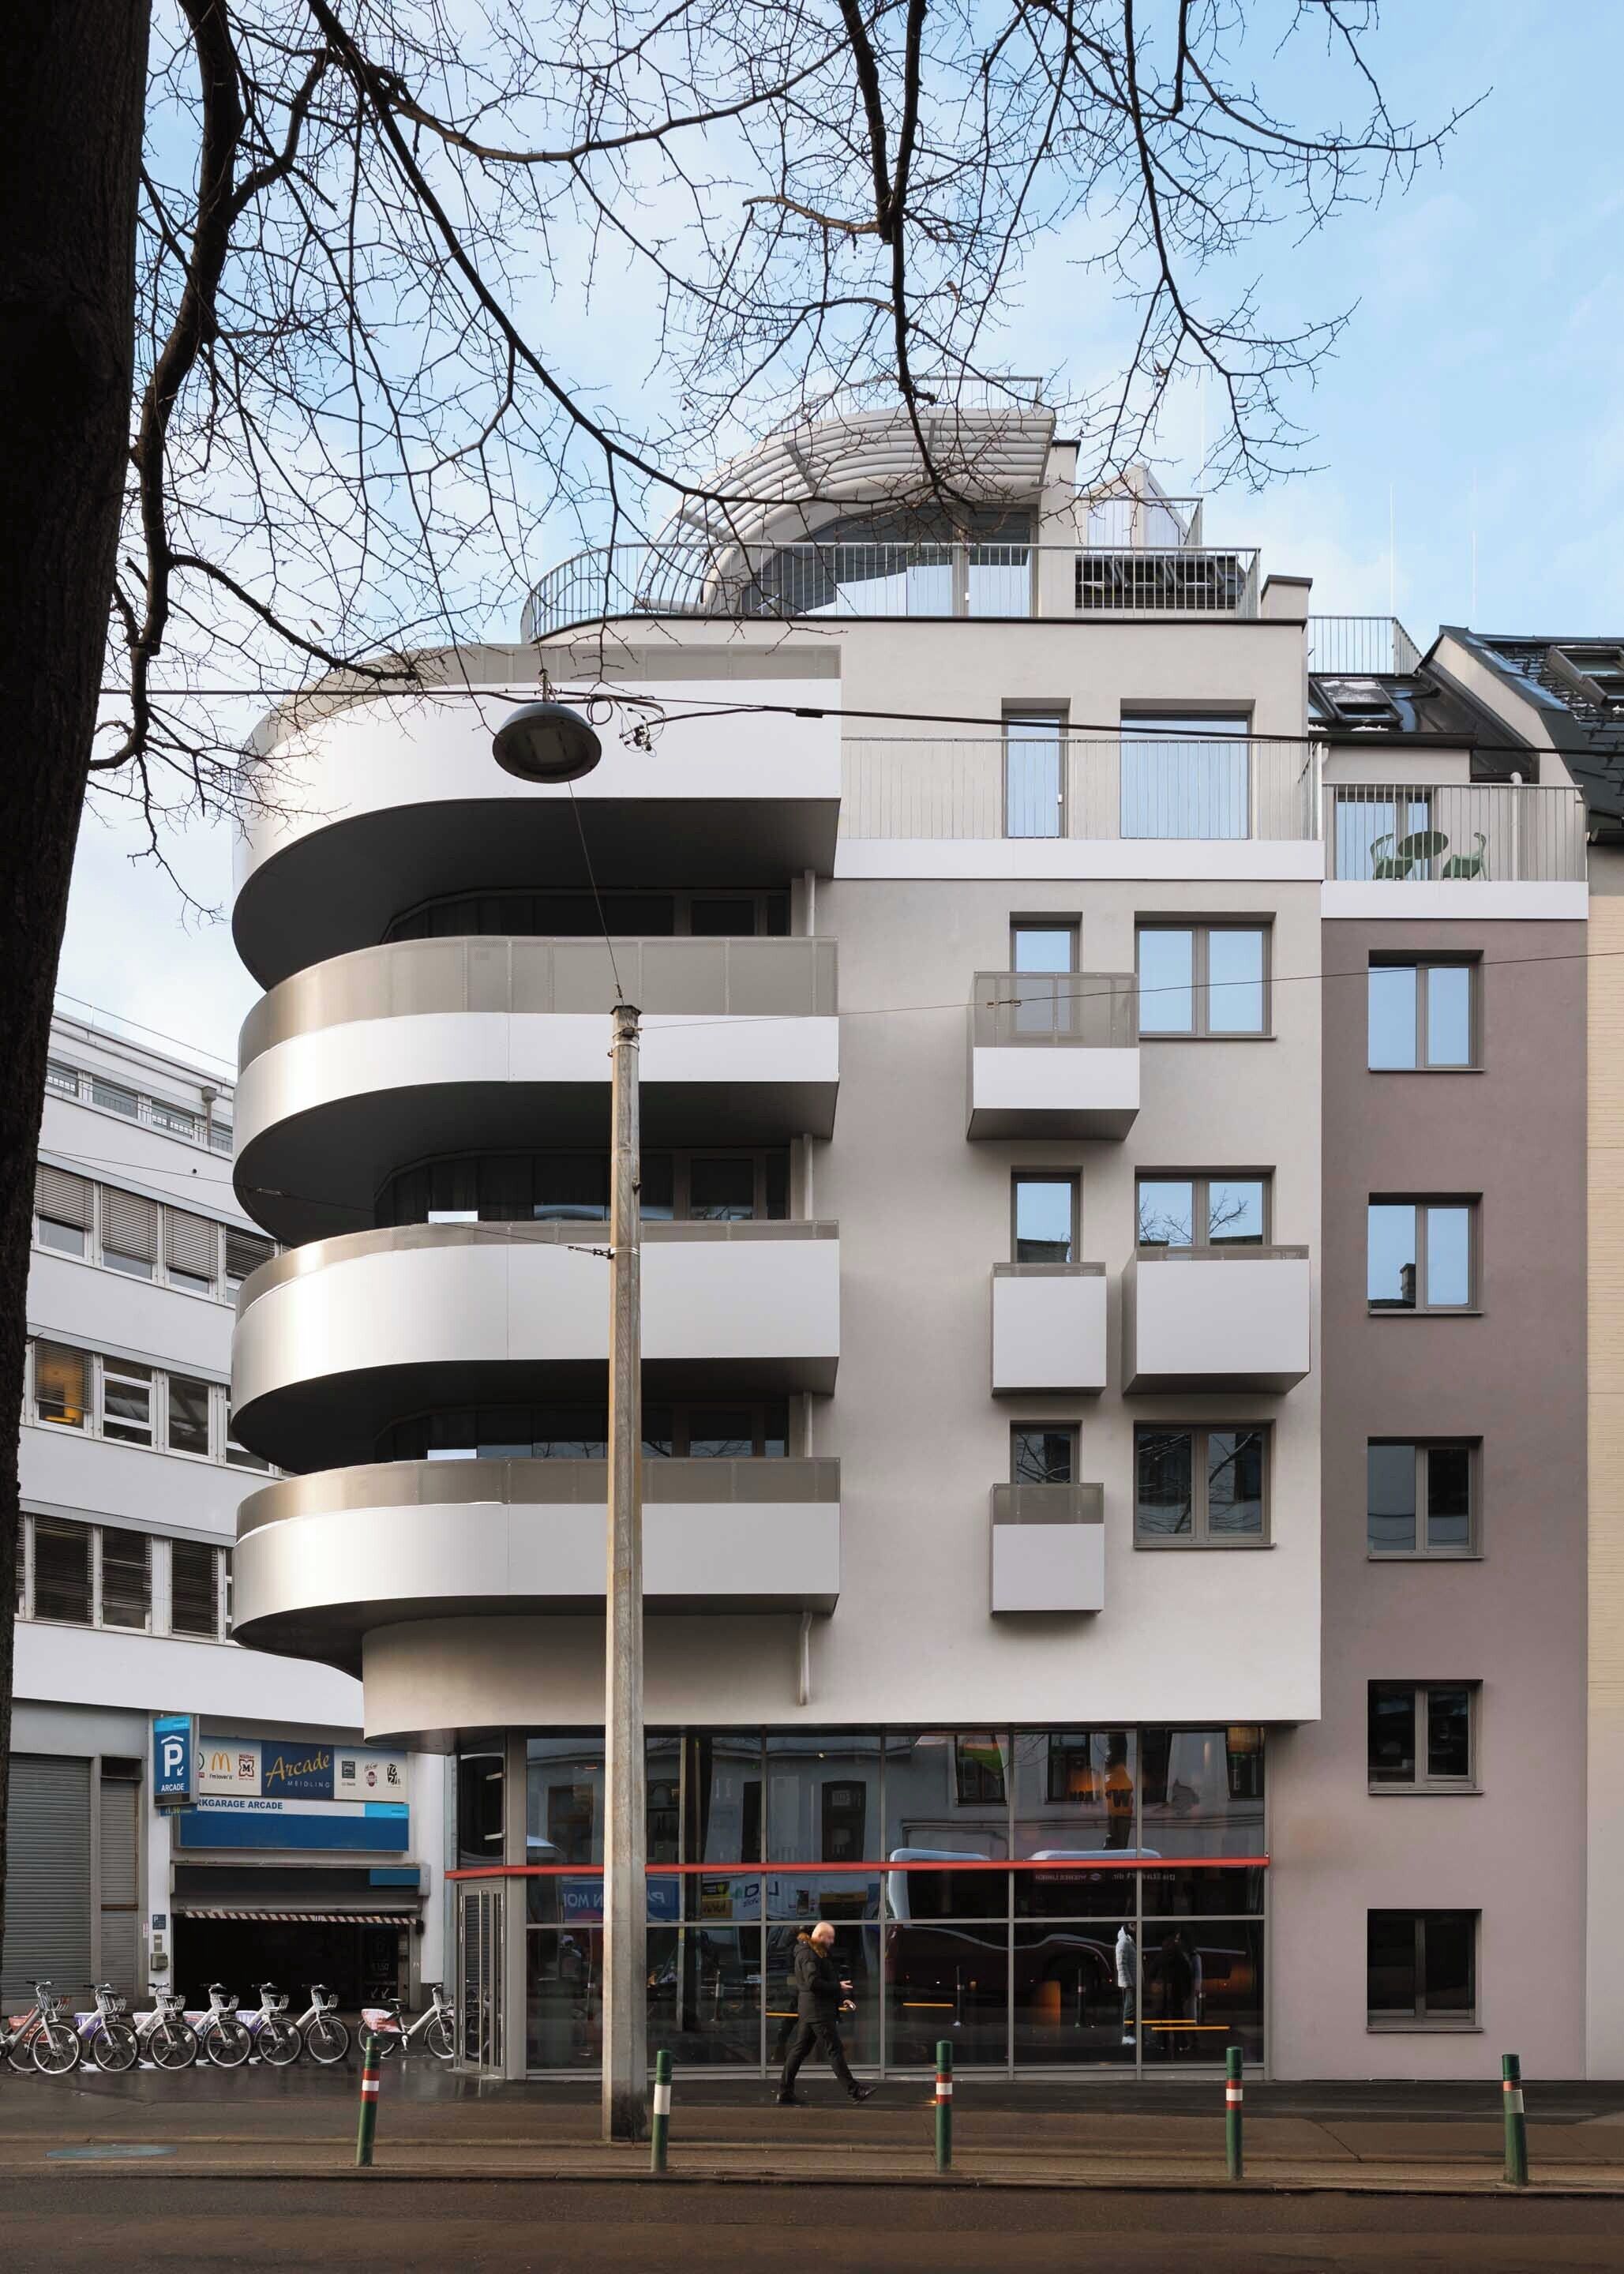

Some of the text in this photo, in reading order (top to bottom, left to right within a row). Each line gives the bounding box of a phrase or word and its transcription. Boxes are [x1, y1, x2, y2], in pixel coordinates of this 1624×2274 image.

[164, 1743, 183, 1777] P
[242, 1764, 251, 1773] M
[265, 1750, 329, 1788] Arcade
[161, 1783, 184, 1792] ARCADE
[287, 1780, 331, 1788] MEIDLING
[247, 1801, 283, 1810] ARCADE
